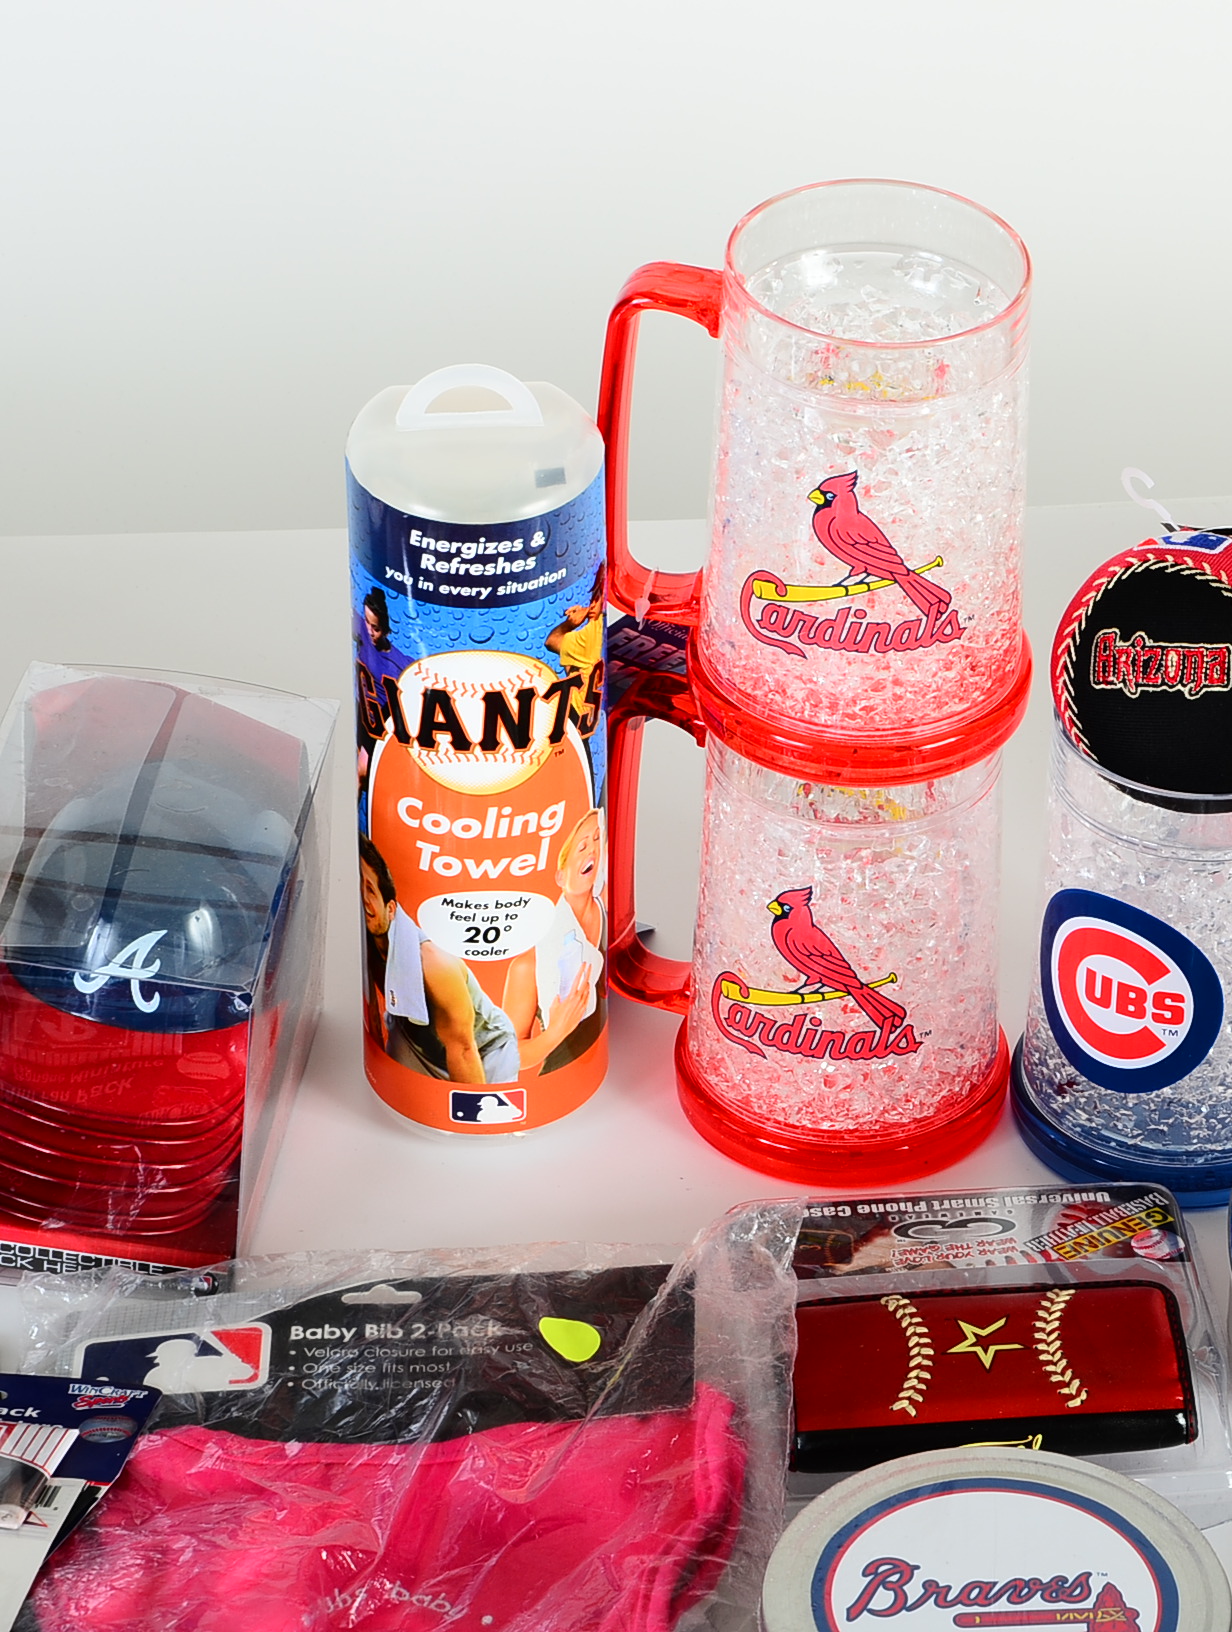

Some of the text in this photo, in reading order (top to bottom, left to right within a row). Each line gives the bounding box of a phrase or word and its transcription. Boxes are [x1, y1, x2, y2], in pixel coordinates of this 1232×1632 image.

[409, 529, 546, 559] Energizes &
[420, 554, 537, 576] Refreshes
[385, 565, 567, 600] you in every situation
[740, 570, 968, 659] Cardinals
[1092, 630, 1232, 698] Arizona
[356, 659, 604, 753] GIANTS
[397, 797, 566, 839] Cooling
[415, 837, 550, 879] Towel
[441, 896, 531, 910] Makes body
[450, 911, 519, 925] feel up to
[464, 947, 509, 957] cooler
[711, 971, 924, 1059] Cardinals
[857, 1200, 928, 1214] Phone
[931, 1197, 1000, 1211] Smart
[1003, 1191, 1111, 1207] Universal
[1056, 1210, 1169, 1259] GENUINE
[289, 1322, 501, 1342] Baby Bib 2-Pack
[304, 1341, 534, 1358] Velcro closure for easy use
[303, 1361, 451, 1374] One size fits most
[845, 1557, 1093, 1622] Braves
